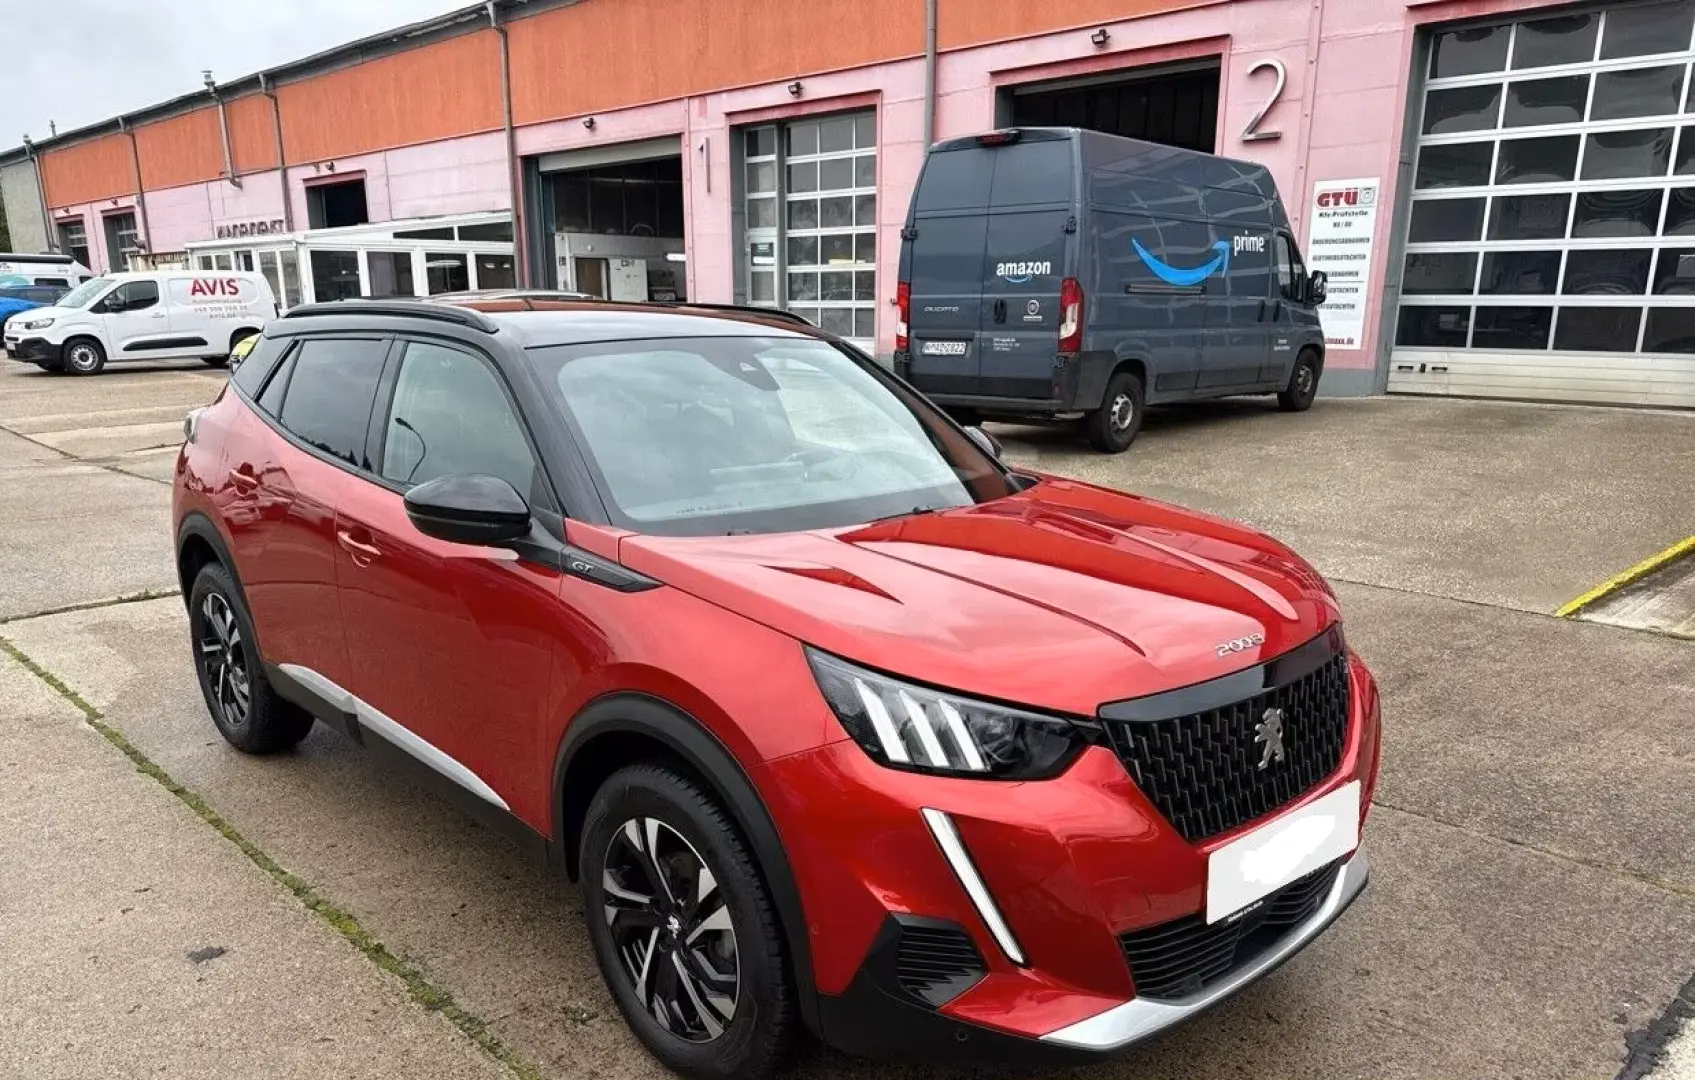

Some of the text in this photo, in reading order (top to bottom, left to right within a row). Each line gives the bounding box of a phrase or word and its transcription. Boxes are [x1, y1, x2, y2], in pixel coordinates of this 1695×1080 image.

[1240, 58, 1287, 142] 2
[1317, 188, 1359, 207] GTÜ
[1234, 230, 1264, 256] prime
[996, 261, 1051, 276] amazon
[191, 278, 239, 295] AVIS
[572, 561, 593, 573] GT
[1215, 632, 1264, 657] 2008
